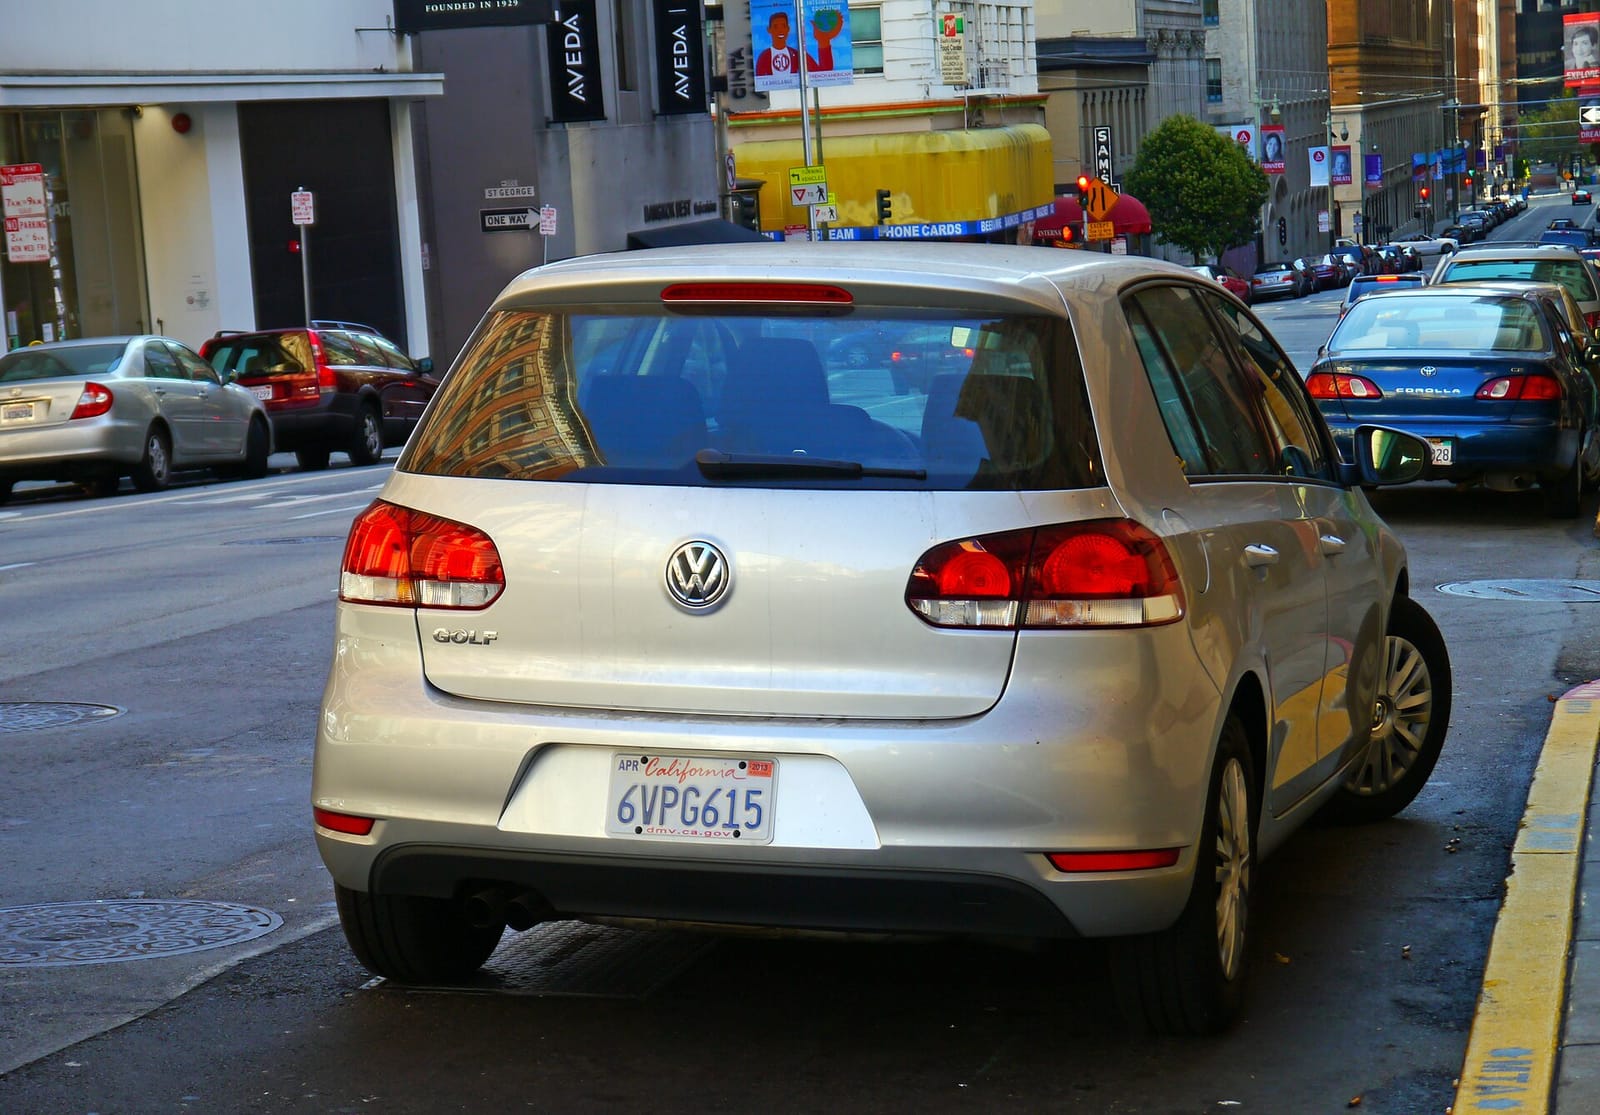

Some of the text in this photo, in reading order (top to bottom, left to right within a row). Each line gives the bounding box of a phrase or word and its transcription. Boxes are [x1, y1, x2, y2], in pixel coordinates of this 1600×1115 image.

[425, 2, 475, 12] FOUNDED
[480, 0, 492, 9] IN
[563, 14, 586, 102] AVEDA
[672, 25, 690, 100] AVEDA
[1580, 130, 1600, 138] DREA
[488, 187, 532, 197] ST GEORGE
[19, 221, 47, 229] PARKING
[487, 215, 527, 226] ONE WAY
[922, 223, 962, 236] CARDS
[1038, 229, 1063, 237] INTERNA
[432, 627, 499, 645] GOLF
[618, 756, 768, 784] APR California 2013
[617, 784, 762, 830] 6VPG615
[646, 826, 732, 838] dmv.ca.gov
